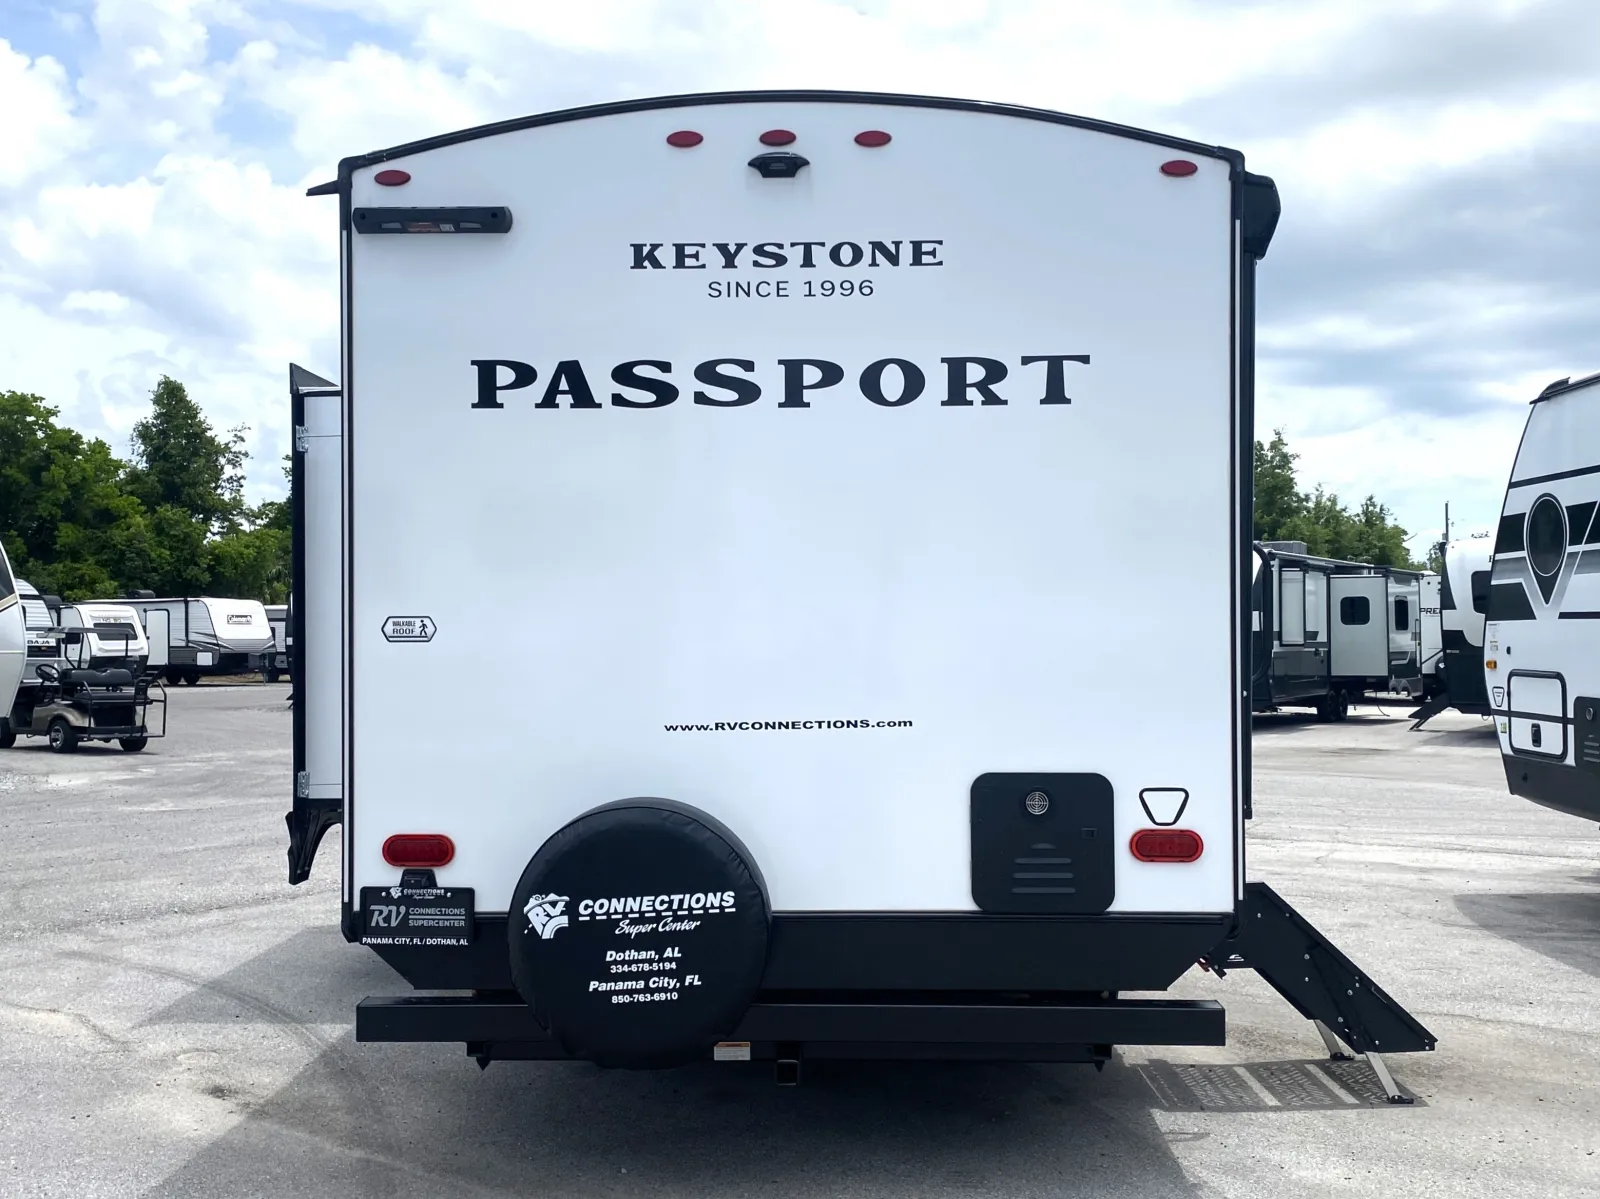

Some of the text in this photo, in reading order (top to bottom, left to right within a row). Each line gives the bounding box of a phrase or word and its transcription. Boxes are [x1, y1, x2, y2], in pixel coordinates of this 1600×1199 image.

[629, 239, 944, 270] KEYSTONE
[707, 279, 874, 298] SINCE 1996
[470, 355, 1090, 409] PASSPORT
[392, 627, 416, 635] ROOF
[664, 719, 913, 732] www.RVCONNECTIONS.com
[578, 891, 736, 915] CONNECTIONS
[369, 905, 406, 927] RV
[409, 907, 466, 915] CONNECTIONS
[408, 919, 465, 927] SUPERCENTER
[615, 917, 701, 939] Super Center
[362, 937, 393, 945] PANAMA
[395, 937, 412, 946] CITY,
[426, 938, 458, 946] DOTHAN,
[459, 938, 468, 946] AL
[605, 947, 682, 962] Dothan, AL
[610, 961, 677, 973] 334-678-5194
[588, 975, 702, 992] Panama City, FL
[611, 991, 679, 1004] 850-763-6910
